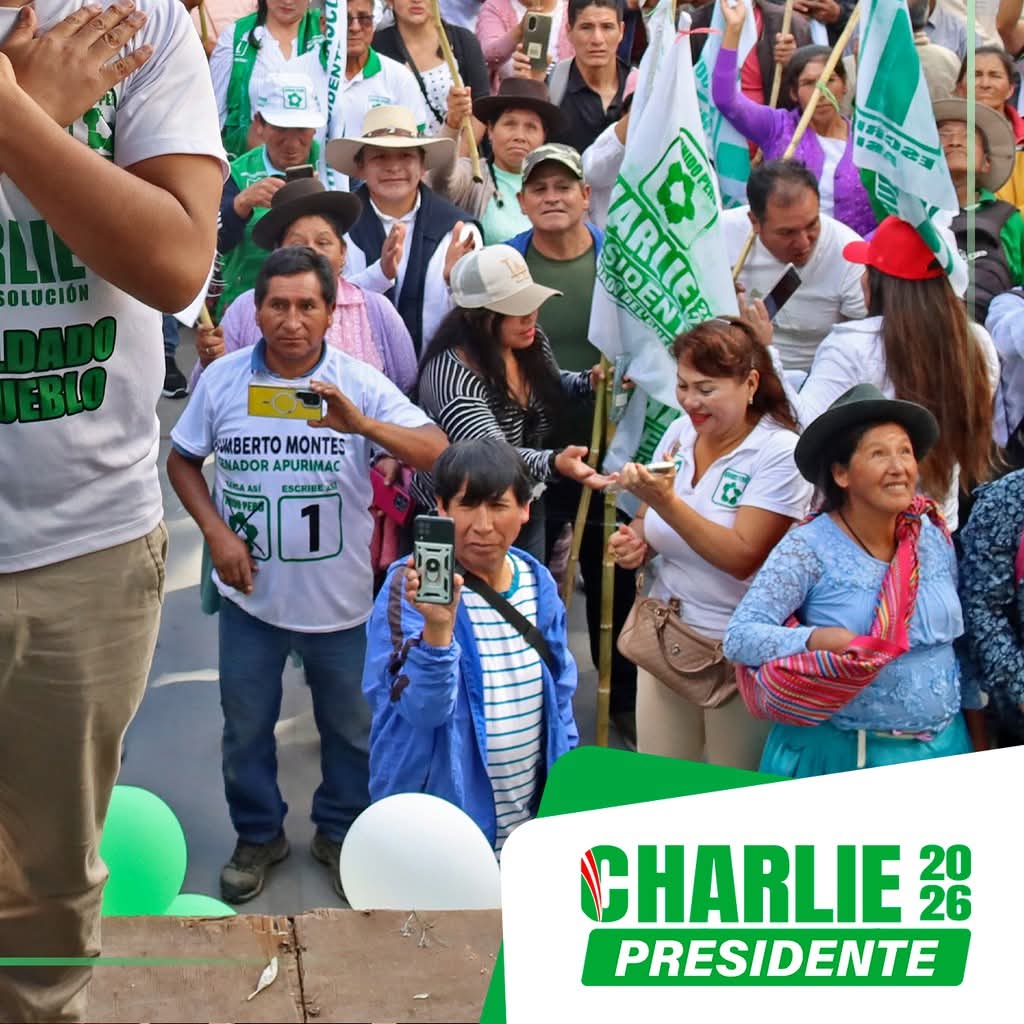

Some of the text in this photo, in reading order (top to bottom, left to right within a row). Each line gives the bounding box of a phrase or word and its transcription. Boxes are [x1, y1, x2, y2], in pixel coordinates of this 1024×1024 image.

[286, 436, 346, 456] MONTES
[281, 483, 324, 493] ESCRIBE
[300, 503, 321, 553] 1
